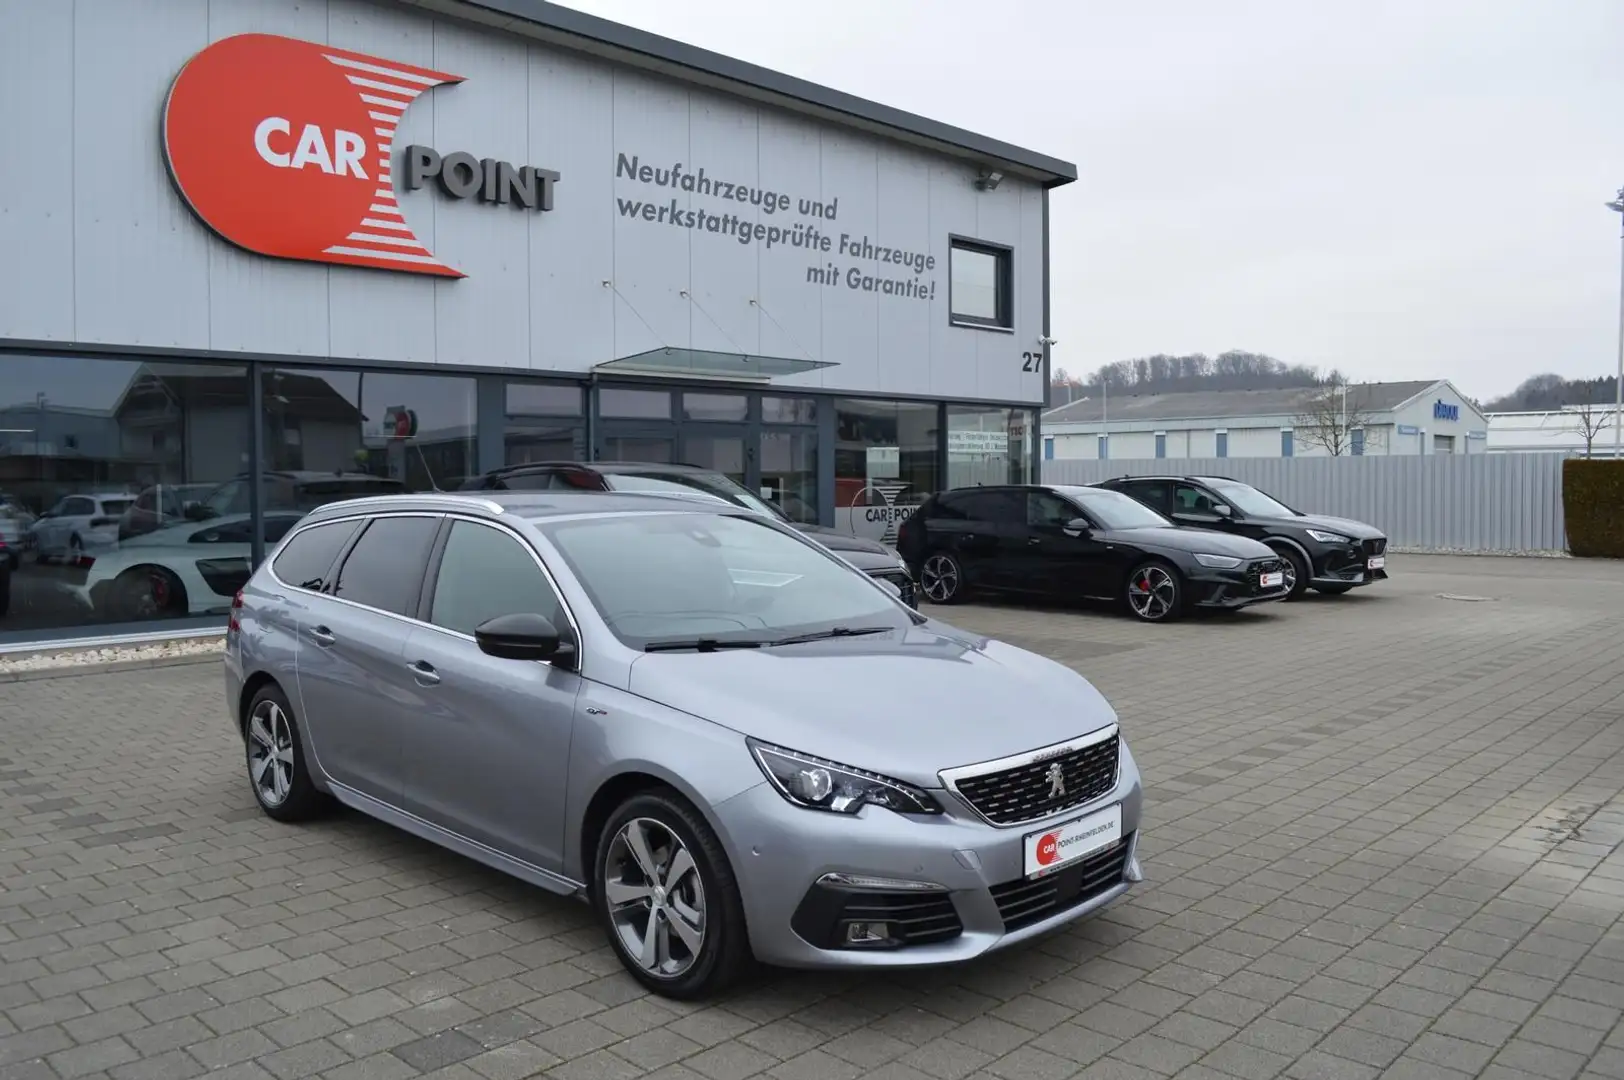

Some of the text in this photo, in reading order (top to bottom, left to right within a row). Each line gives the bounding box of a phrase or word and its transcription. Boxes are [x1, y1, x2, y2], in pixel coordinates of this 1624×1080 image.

[254, 116, 561, 212] CAR POINT
[616, 153, 838, 220] Neufahrzeuge und
[617, 197, 936, 274] werkstattgeprüfte Fahrzeuge
[806, 262, 936, 300] mit Garantie!
[1022, 352, 1042, 373] 27
[865, 507, 918, 522] CAR POI
[1043, 843, 1055, 854] CAR
